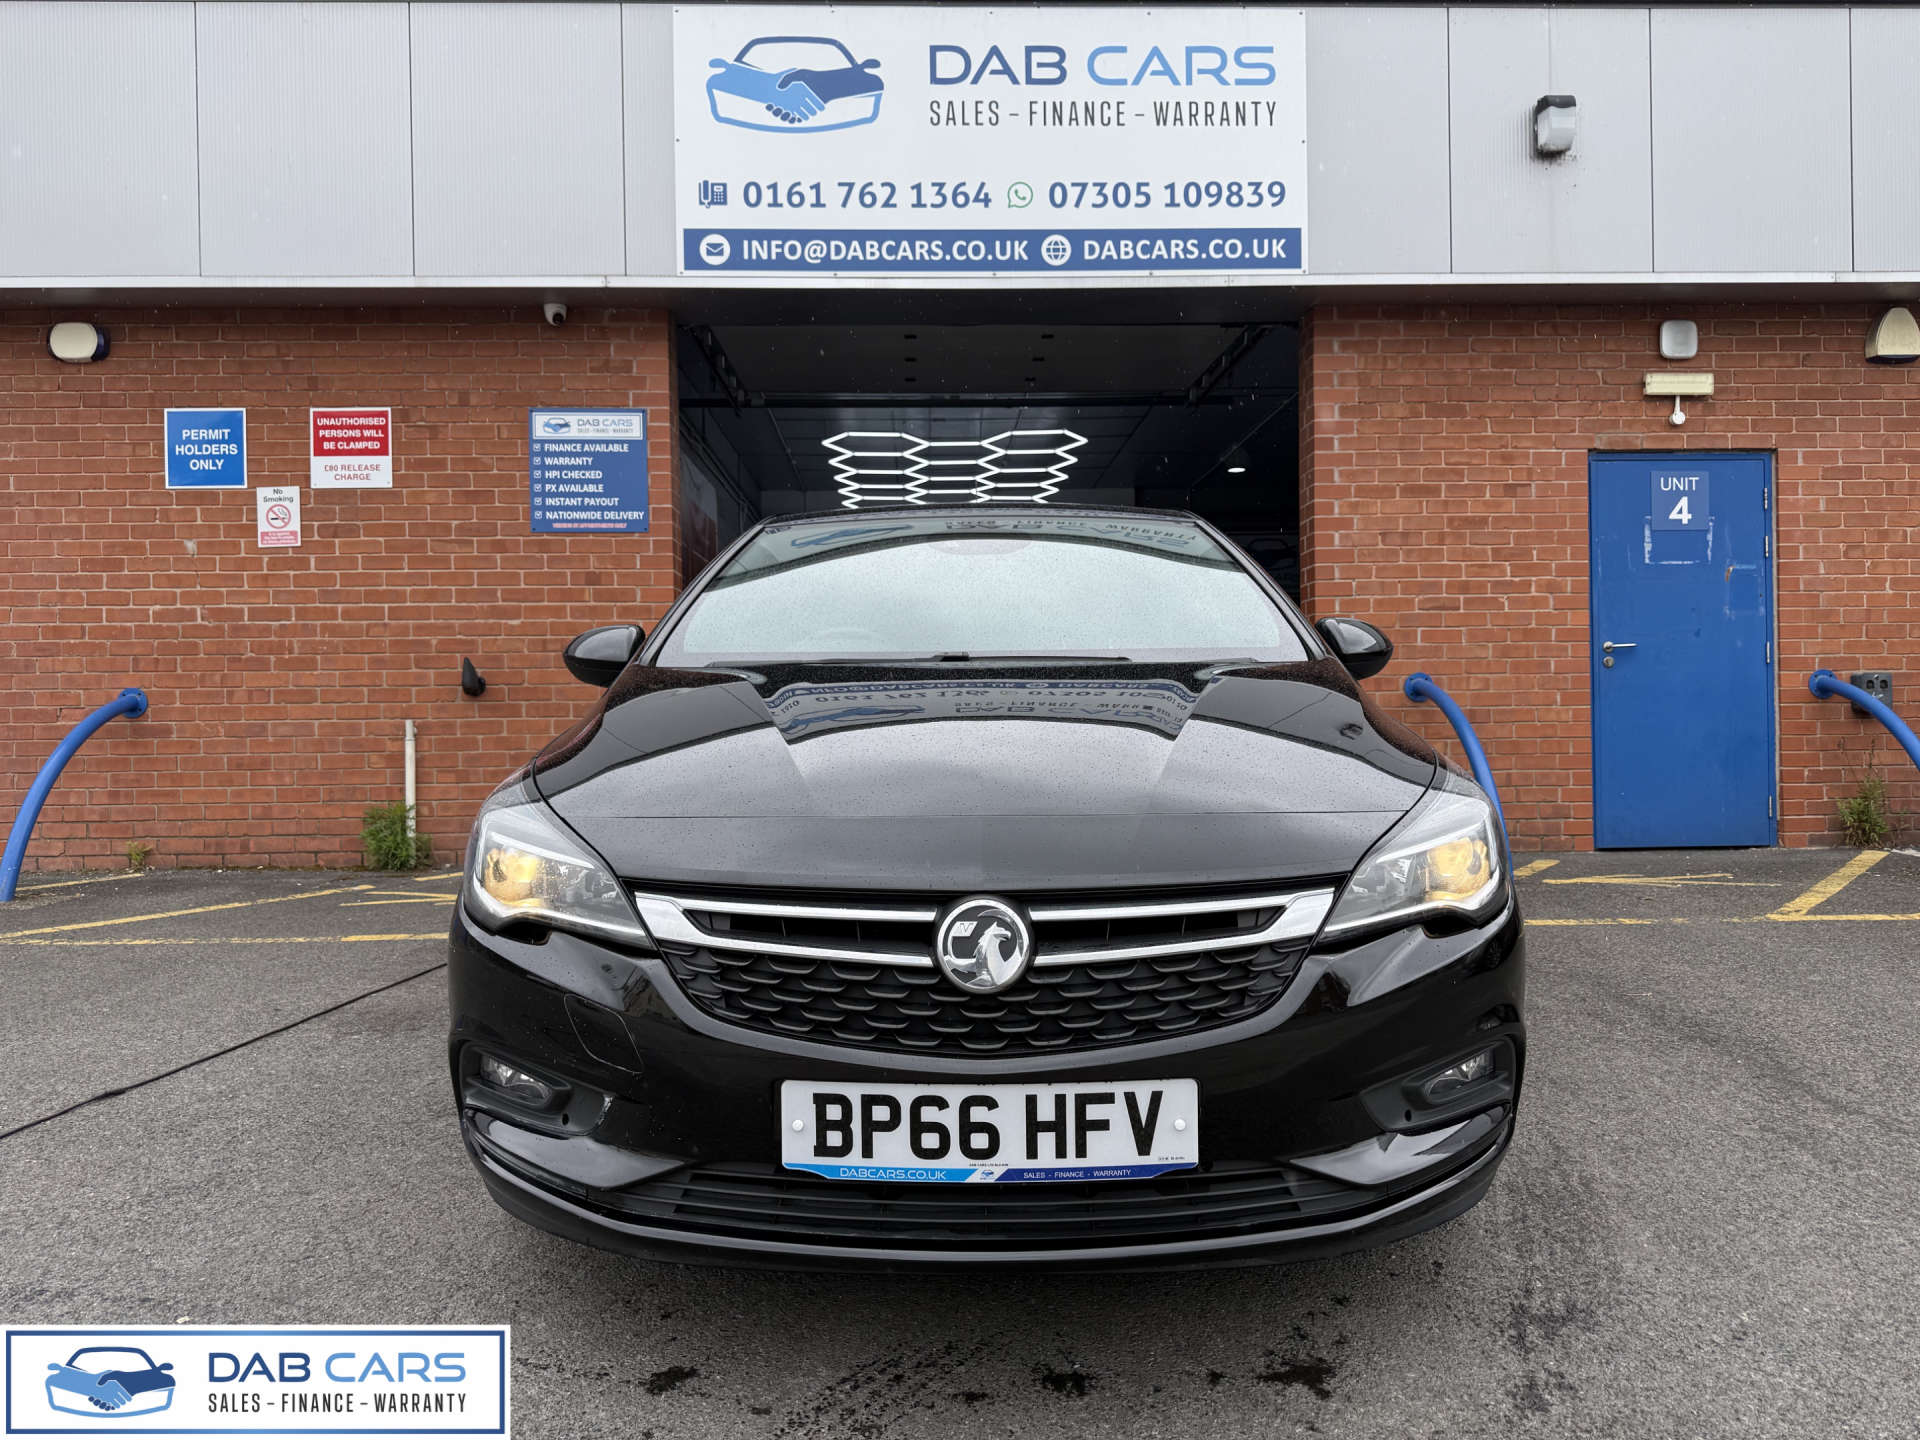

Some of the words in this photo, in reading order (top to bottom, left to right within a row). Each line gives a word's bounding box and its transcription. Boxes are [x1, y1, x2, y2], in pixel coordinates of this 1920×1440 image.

[929, 45, 1067, 85] DAB
[1087, 46, 1276, 86] CARS
[930, 101, 999, 126] SALES
[1030, 101, 1125, 126] FINANCE
[1154, 101, 1276, 126] WARRANTY
[744, 182, 826, 208] 0161
[838, 182, 897, 208] 762
[911, 182, 991, 208] 1364
[1049, 182, 1151, 208] 07305
[1164, 181, 1285, 208] 109839
[744, 240, 1028, 263] INFO@DABCARS.CO.UK
[1084, 239, 1286, 259] DABCARS.CO.UK
[317, 418, 386, 426] UNAUTHORISED
[182, 429, 230, 440] PERMIT
[319, 430, 361, 438] PERSONS
[363, 429, 384, 437] WILL
[176, 444, 238, 455] HOLDERS
[338, 441, 380, 450] CLAMPED
[544, 444, 582, 452] FINANCE
[583, 444, 629, 452] AVAILABLE
[190, 459, 224, 470] ONLY
[544, 457, 593, 465] WARRANTY
[341, 464, 381, 472] RELEASE
[545, 471, 560, 479] HPI
[562, 471, 603, 479] CHECKED
[545, 484, 557, 492] PX
[558, 484, 604, 492] AVAILABLE
[1661, 477, 1699, 491] UNIT
[545, 498, 583, 506] INSTANT
[584, 498, 619, 506] PAYOUT
[545, 511, 602, 520] NATIONWIDE
[603, 511, 644, 520] DELIVERY
[1669, 497, 1692, 524] 4
[813, 1093, 1000, 1160] BP66
[1026, 1091, 1163, 1159] HFV
[839, 1168, 946, 1180] DABCARS.CO.UK
[1054, 1170, 1082, 1178] FINANCE
[1093, 1169, 1132, 1177] WARRANTY
